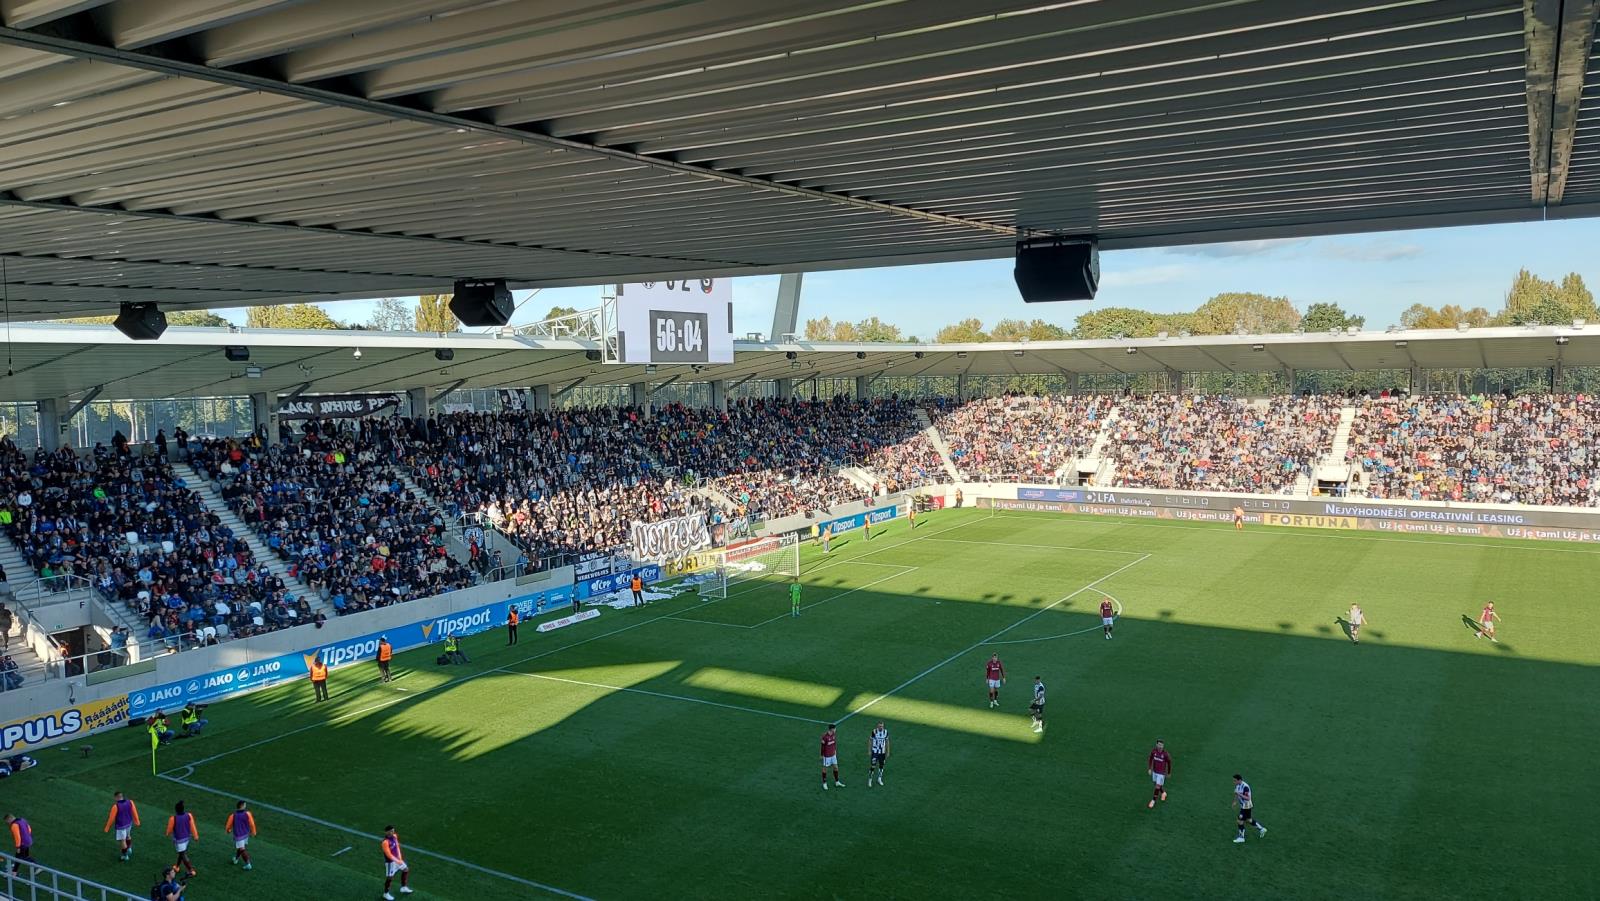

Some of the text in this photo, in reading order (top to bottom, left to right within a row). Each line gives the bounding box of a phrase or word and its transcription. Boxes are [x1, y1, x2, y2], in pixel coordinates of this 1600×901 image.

[657, 318, 702, 352] 56:04
[277, 401, 313, 415] LACK
[320, 400, 363, 414] WHITE
[60, 424, 68, 435] F
[1098, 493, 1116, 503] LFA
[1198, 512, 1217, 520] tam!
[1270, 514, 1350, 528] FORTUNA
[1477, 513, 1523, 524] LEASING
[832, 518, 856, 532] Tipsport
[1394, 522, 1403, 531] je
[1405, 523, 1427, 531] tam!
[1430, 524, 1444, 532] Už
[1446, 525, 1455, 533] je
[1457, 526, 1480, 534] tam!
[1507, 528, 1520, 536] Už
[1523, 530, 1534, 538] je
[1535, 530, 1560, 538] tam!
[1563, 531, 1577, 539] Už
[1580, 532, 1591, 541] je
[437, 608, 491, 635] Tipsport
[321, 634, 388, 666] Tipspor
[252, 661, 281, 677] JAKO
[203, 673, 233, 689] JAKO
[149, 685, 182, 703] JAKO
[0, 709, 82, 751] PULS
